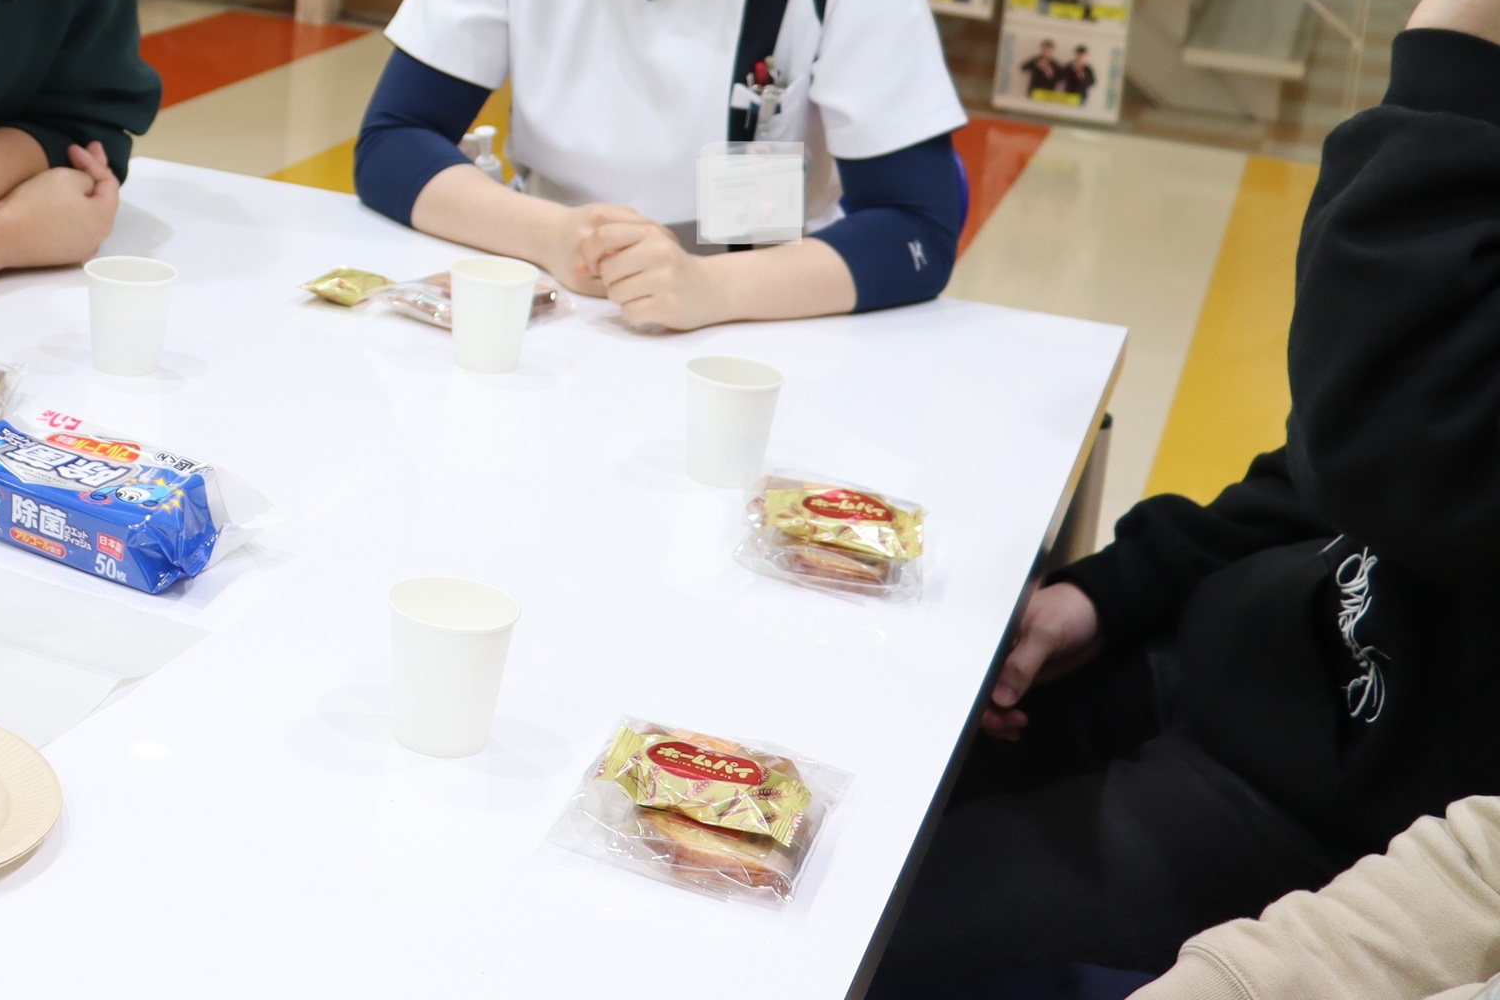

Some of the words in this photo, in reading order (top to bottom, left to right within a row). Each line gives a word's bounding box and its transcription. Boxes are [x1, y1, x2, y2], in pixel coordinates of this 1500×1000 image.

[6, 445, 129, 487] 除菌
[11, 493, 67, 541] 除菌
[14, 530, 63, 556] アルコール配合
[63, 534, 92, 551] ティッシュ
[64, 525, 89, 539] ウエット
[99, 535, 122, 553] 日本製
[94, 552, 127, 583] 50枚
[656, 746, 755, 779] ホームパイ
[694, 765, 717, 775] HOME
[719, 772, 732, 780] PIE
